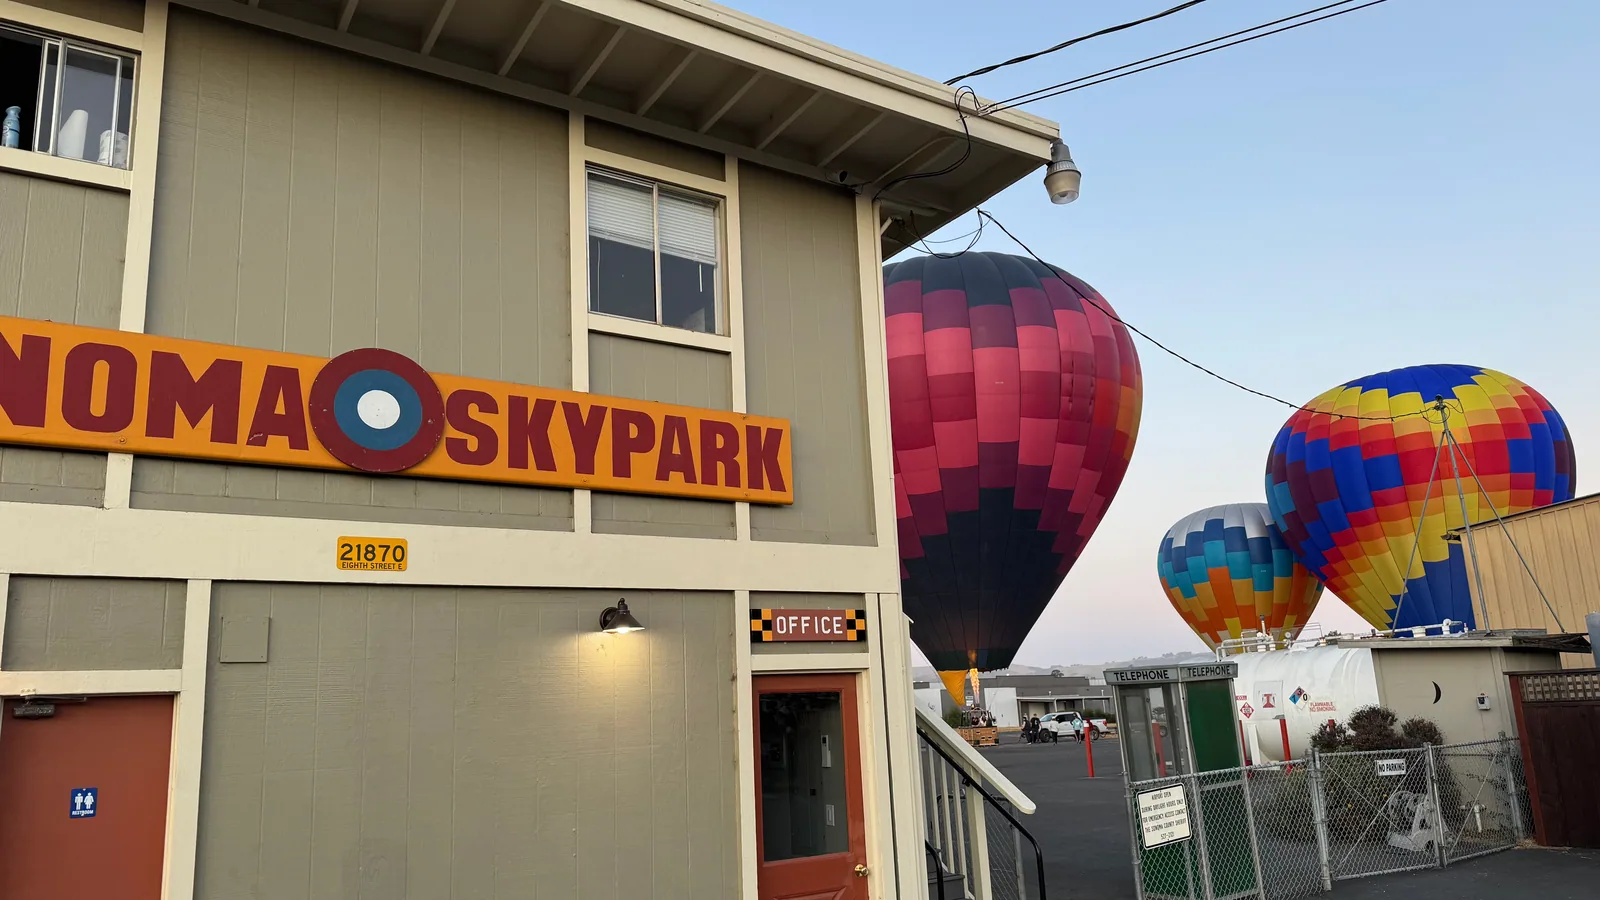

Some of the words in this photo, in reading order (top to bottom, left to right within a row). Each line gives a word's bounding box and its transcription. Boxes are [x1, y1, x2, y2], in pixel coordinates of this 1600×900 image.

[445, 388, 787, 492] SKYPARK
[340, 543, 405, 562] 21870
[776, 616, 843, 634] OFFICE
[1114, 670, 1170, 682] TELEPHONE
[1187, 665, 1230, 677] TELEPHONE
[1302, 694, 1308, 702] 0
[1378, 764, 1385, 772] NO
[1386, 762, 1404, 772] PARKING
